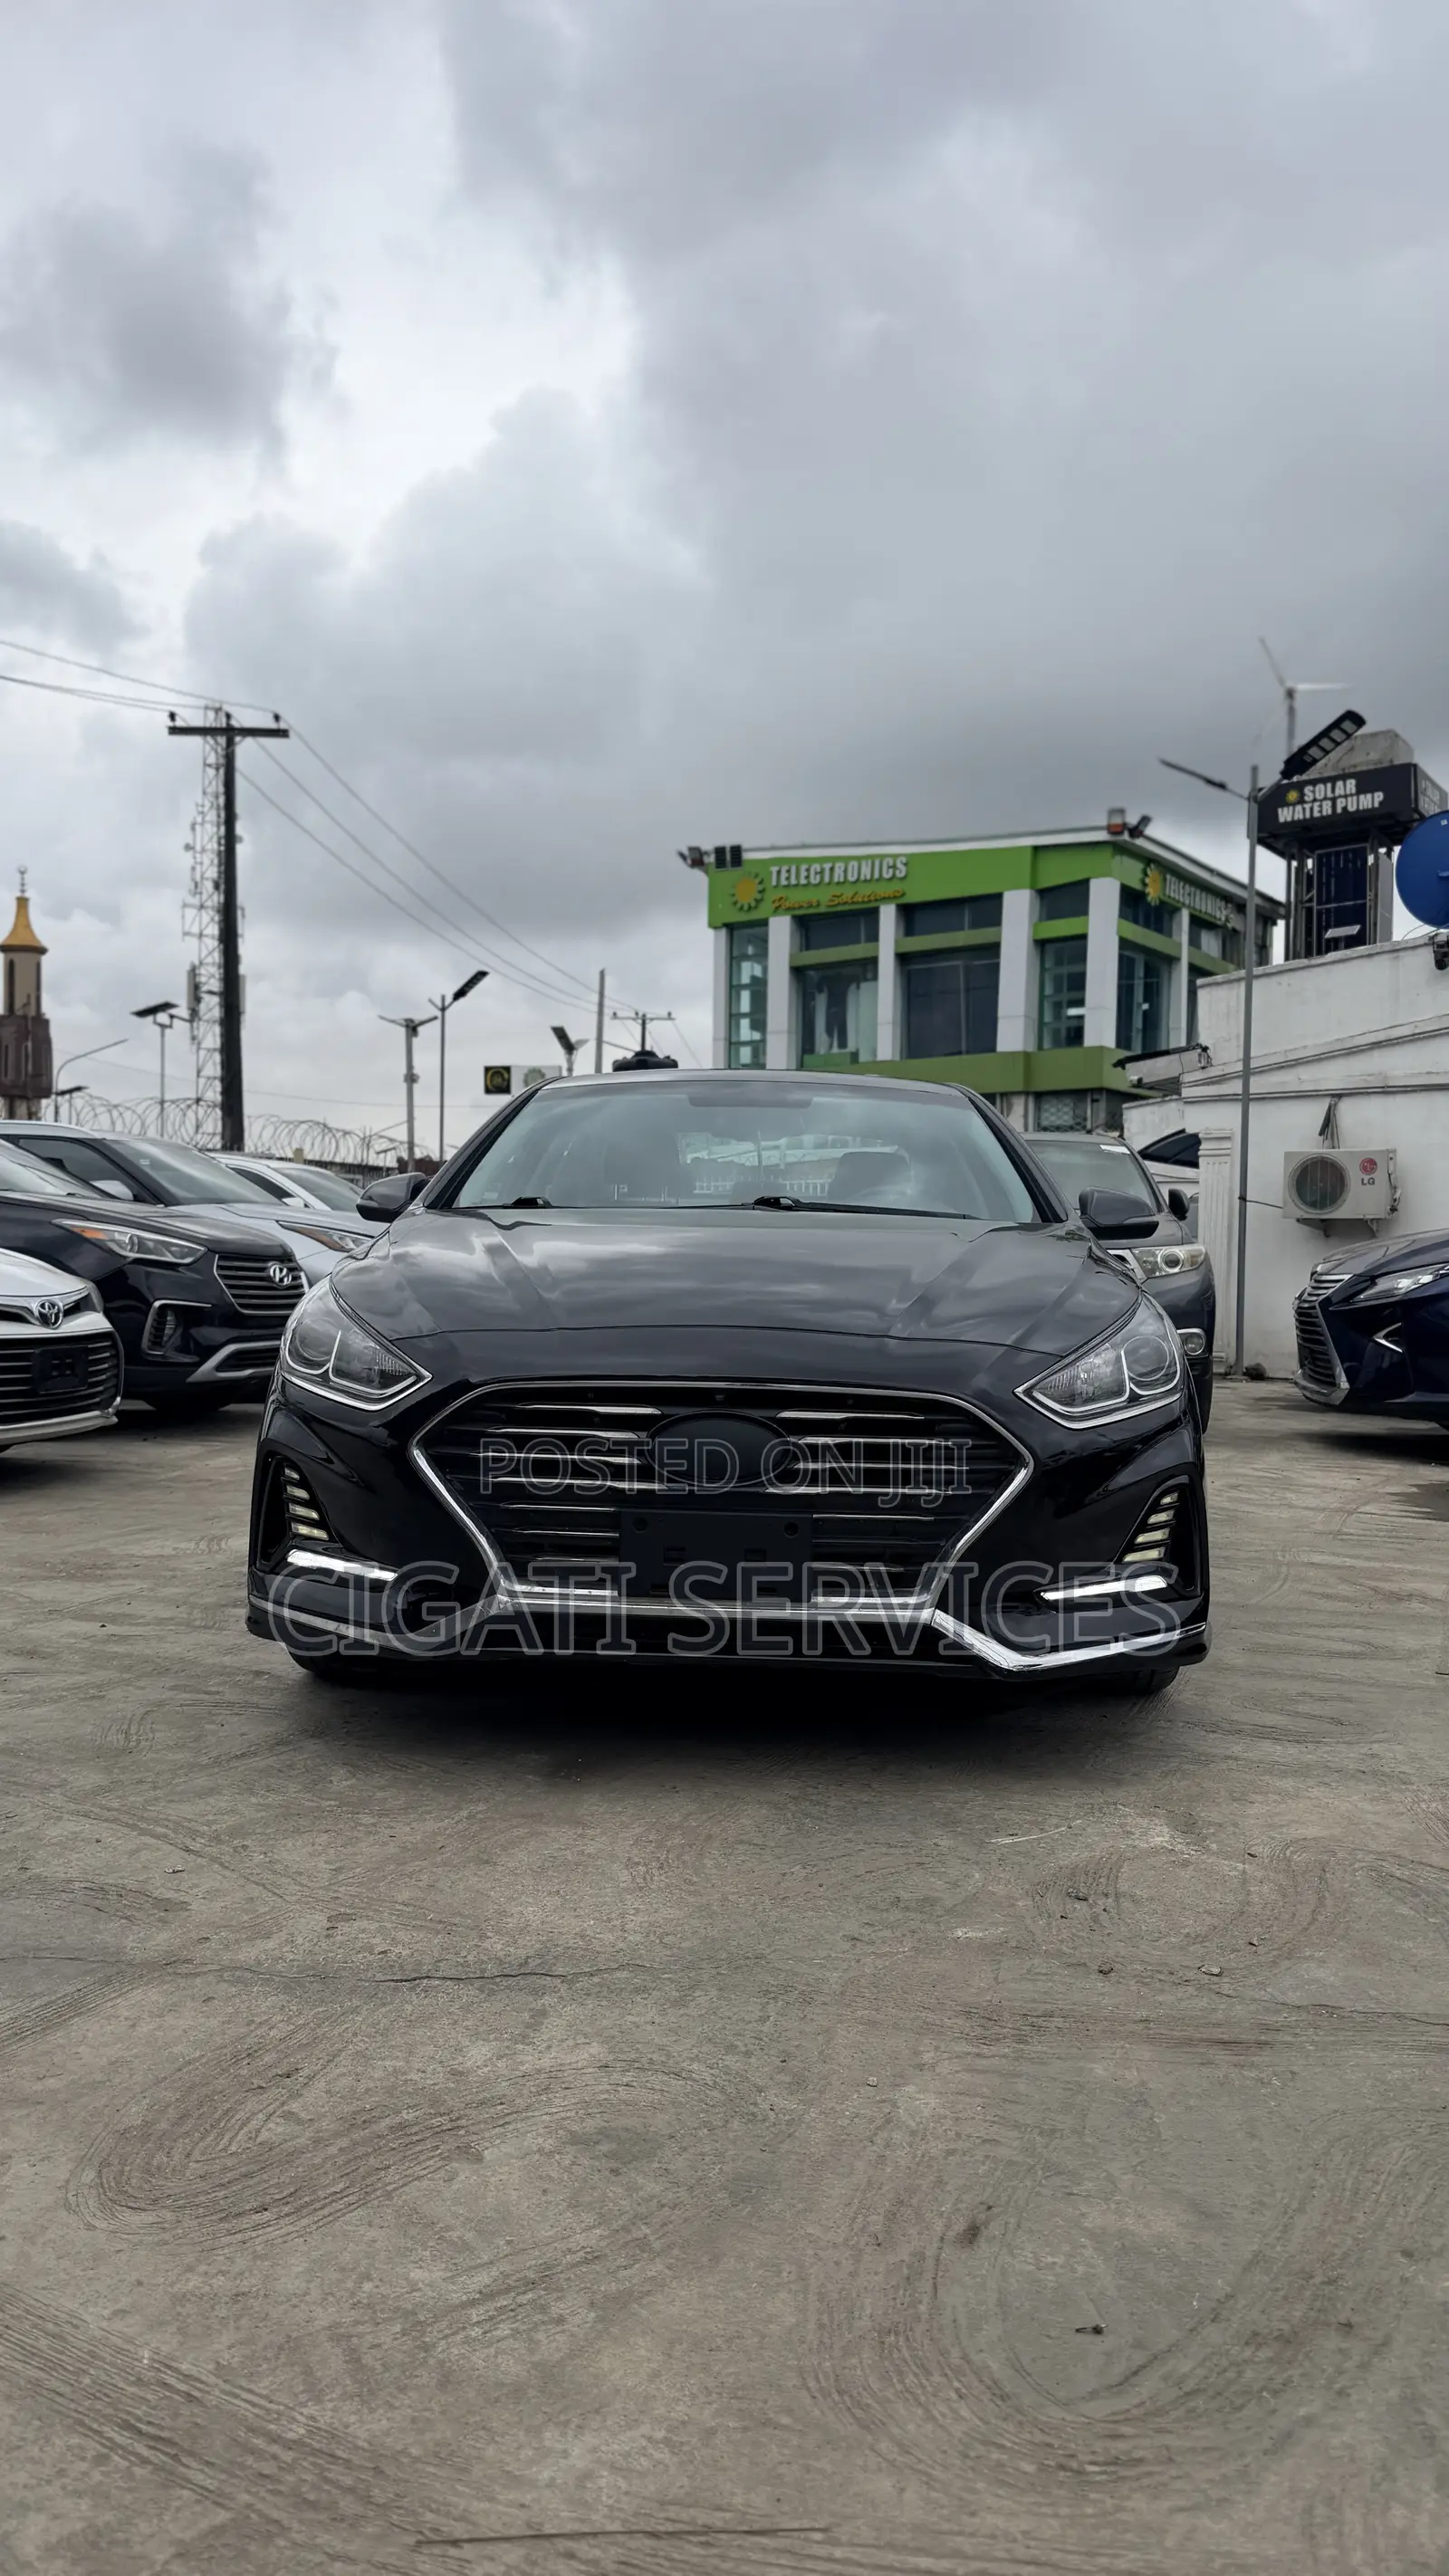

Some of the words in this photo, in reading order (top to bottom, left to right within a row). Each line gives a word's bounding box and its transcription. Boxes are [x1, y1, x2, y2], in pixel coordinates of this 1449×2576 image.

[1303, 779, 1357, 801] SOLAR
[1277, 800, 1333, 823] WATER
[1336, 791, 1384, 814] PUMP
[771, 856, 907, 886] TELECTRONICS
[772, 894, 820, 911] Power
[827, 888, 906, 906] Solutions
[1361, 1177, 1376, 1186] LG
